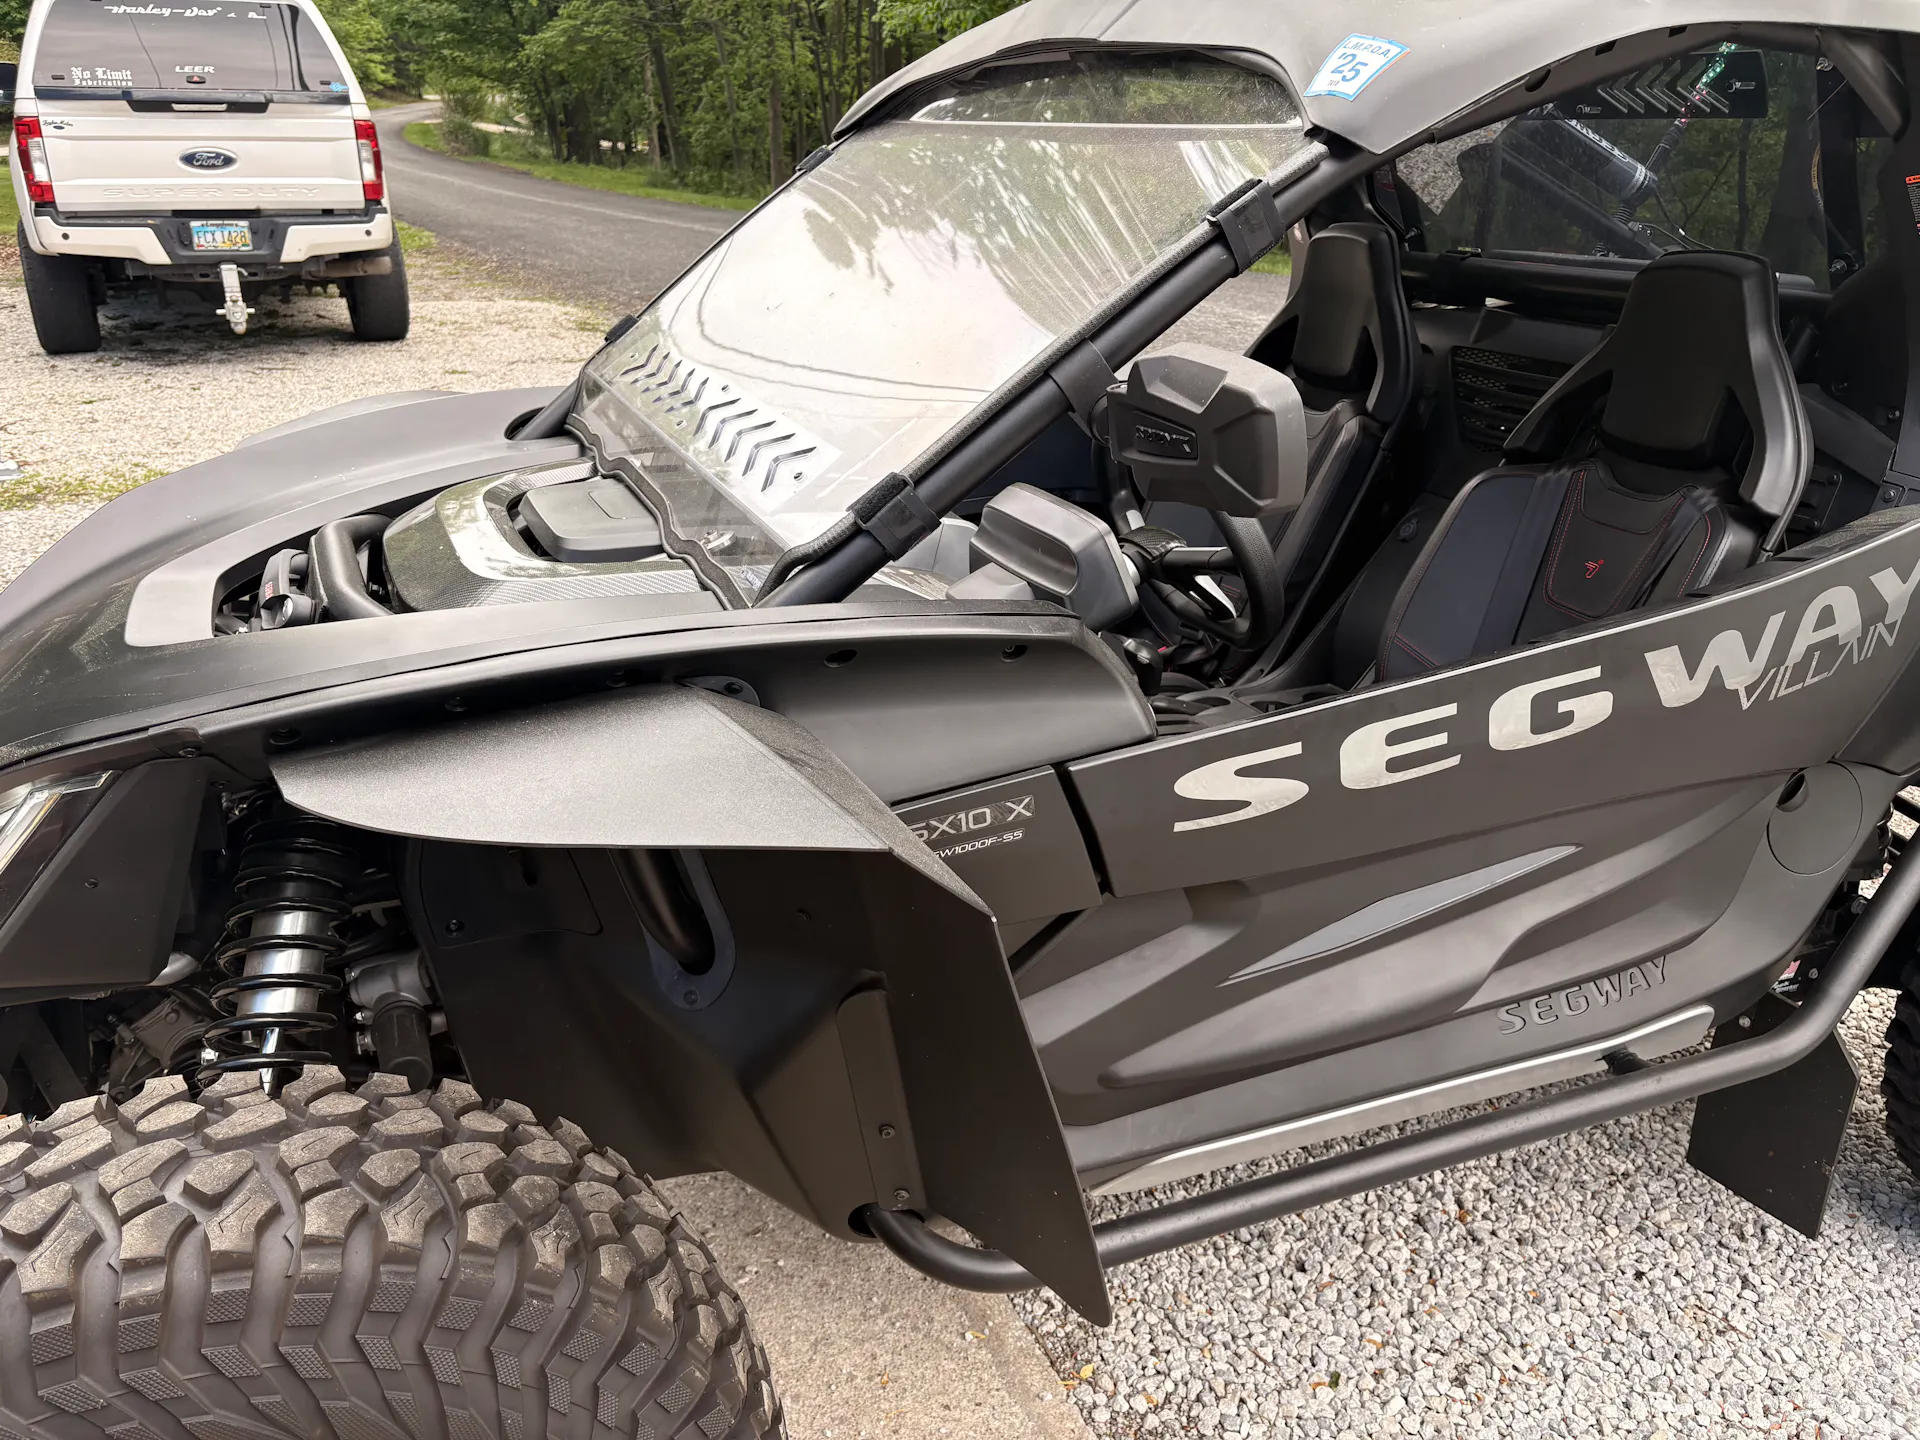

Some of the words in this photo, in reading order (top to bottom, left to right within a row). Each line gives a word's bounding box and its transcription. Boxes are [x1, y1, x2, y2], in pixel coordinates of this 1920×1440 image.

[1342, 40, 1392, 59] L.M.P.O.A.
[71, 67, 91, 79] No
[95, 67, 132, 80] Limit
[175, 65, 215, 73] LEER
[193, 152, 224, 166] Ford
[103, 187, 223, 198] SUPER
[232, 187, 320, 198] DUTY
[196, 230, 218, 244] FCX
[220, 230, 247, 245] 1428
[1737, 619, 1902, 711] VILLAIN
[1173, 557, 1920, 832] SEGWAY
[1005, 796, 1034, 822] X
[1496, 955, 1667, 1035] SEGWAY
